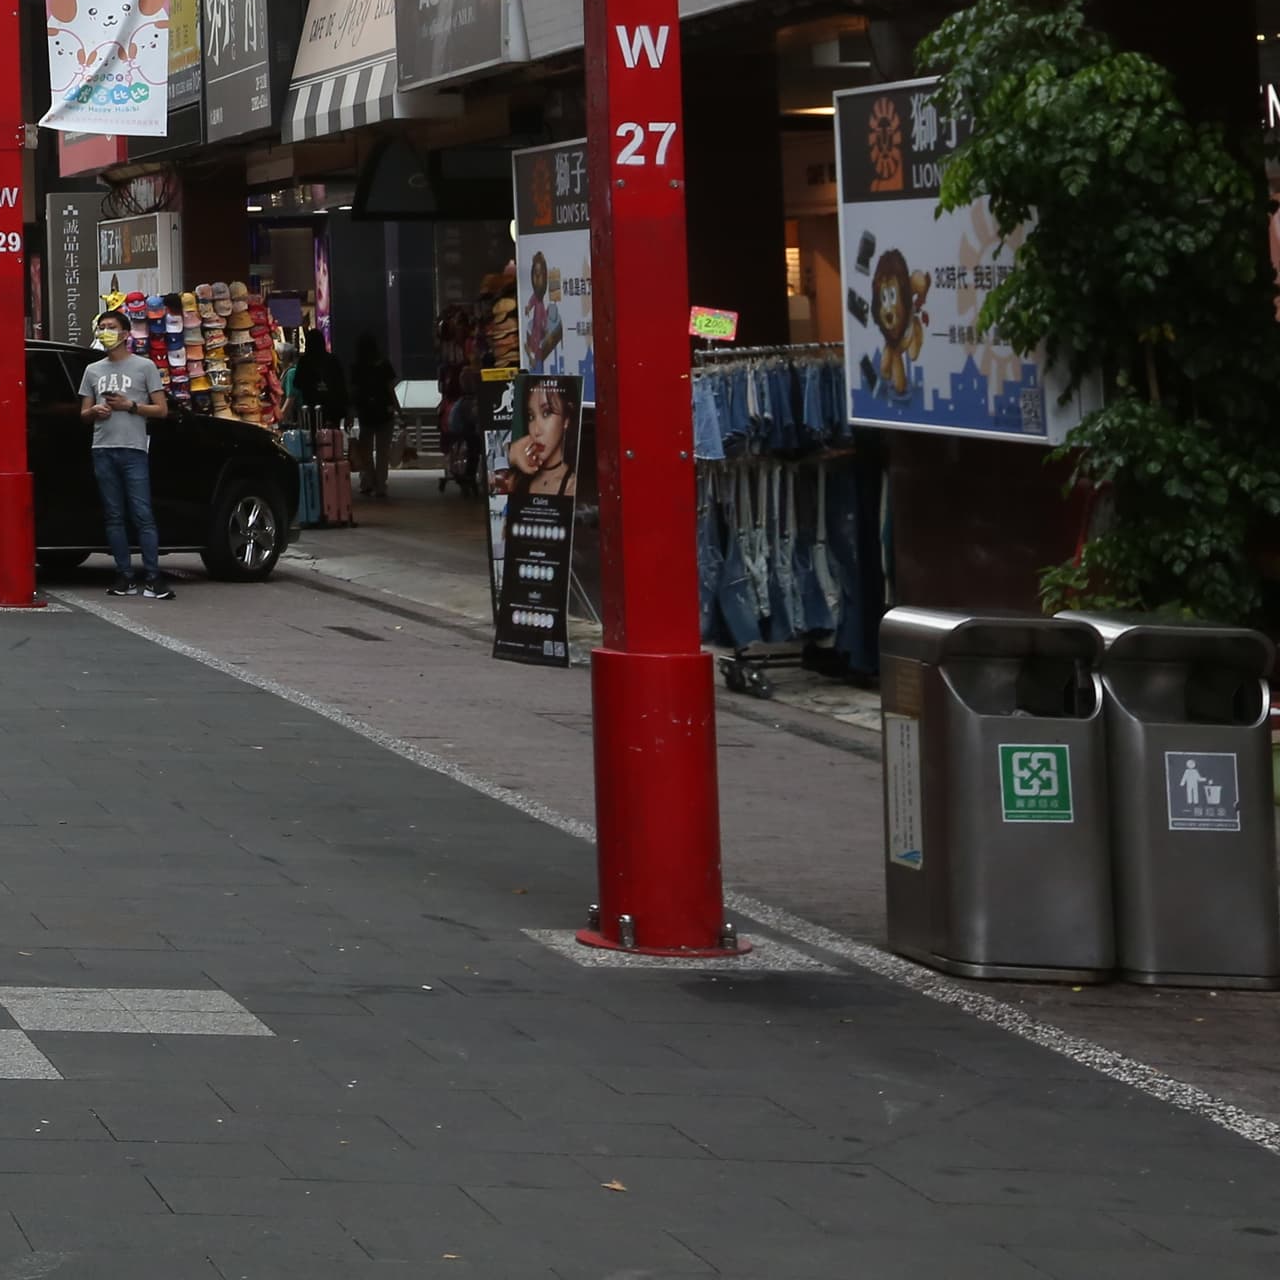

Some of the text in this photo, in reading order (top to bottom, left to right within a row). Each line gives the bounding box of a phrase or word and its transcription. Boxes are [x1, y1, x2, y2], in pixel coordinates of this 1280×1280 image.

[615, 25, 670, 68] W
[616, 122, 677, 166] 27
[63, 219, 80, 286] 誠品生活
[67, 287, 81, 311] the
[97, 372, 133, 394] GAP
